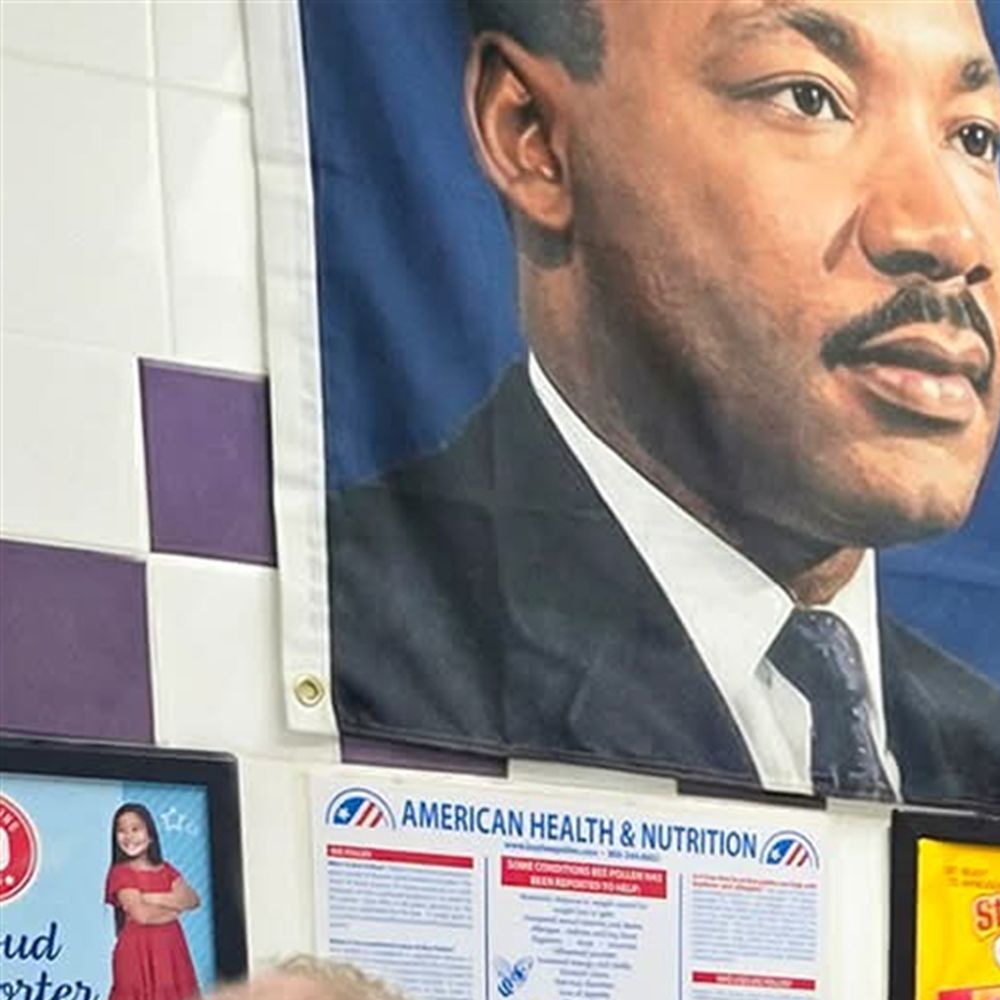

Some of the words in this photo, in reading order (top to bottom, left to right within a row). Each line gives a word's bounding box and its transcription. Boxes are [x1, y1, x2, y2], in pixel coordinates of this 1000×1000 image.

[401, 799, 522, 836] AMERICAN
[530, 812, 614, 845] HEALTH
[620, 820, 636, 848] &
[641, 822, 757, 859] NUTRITION
[0, 921, 62, 961] ud
